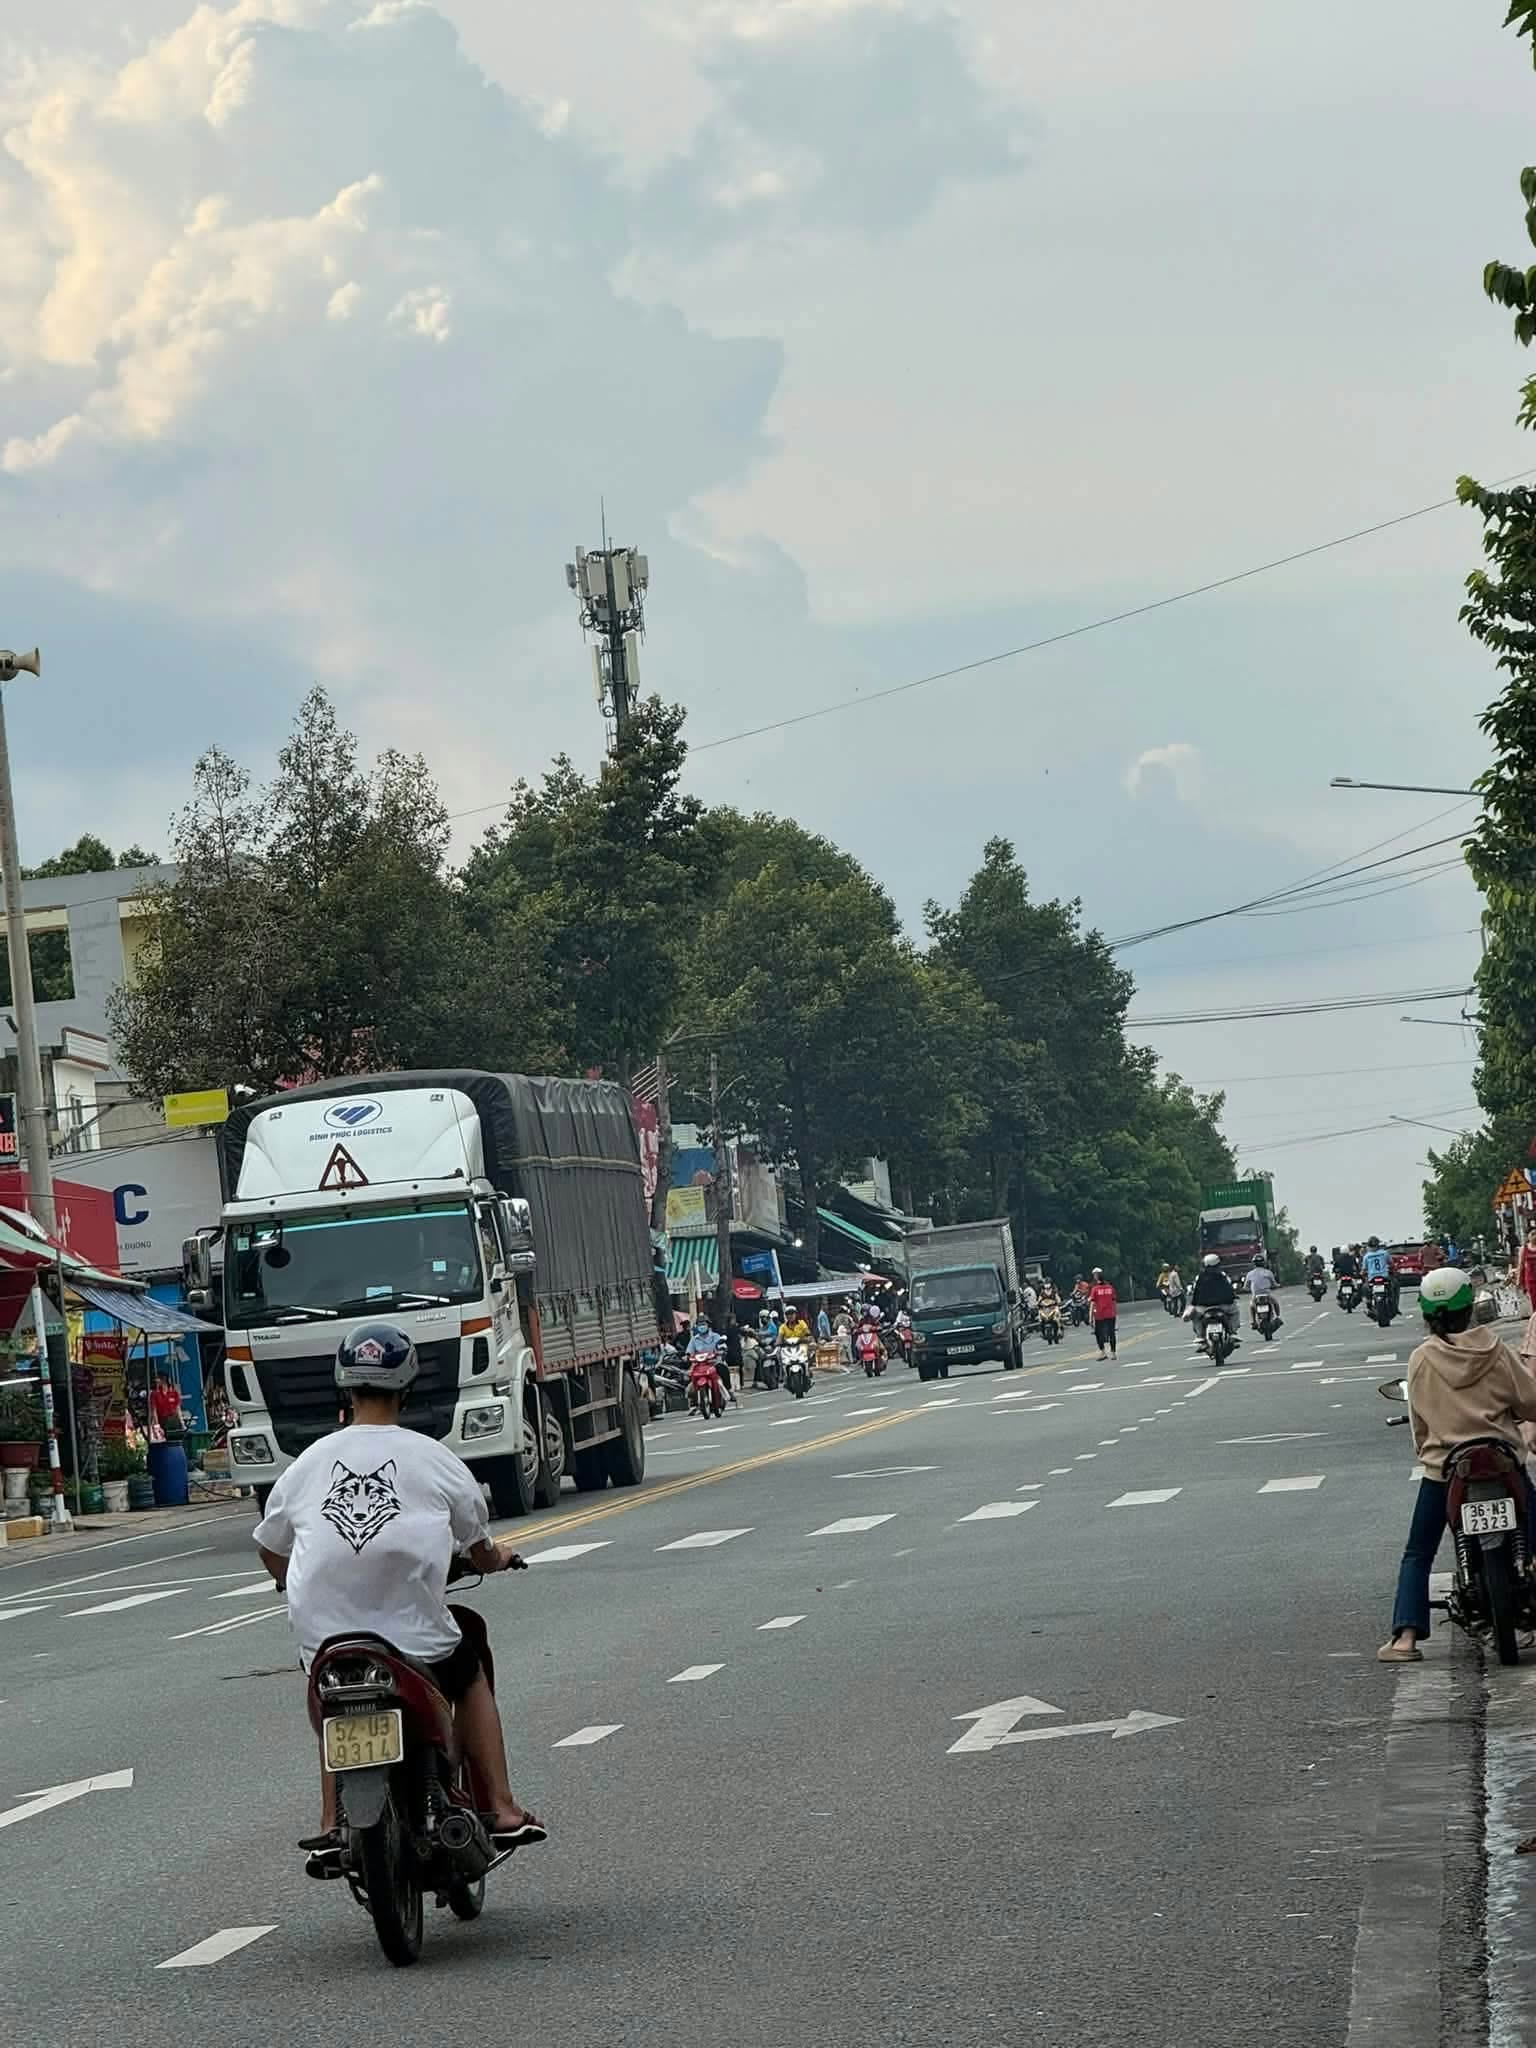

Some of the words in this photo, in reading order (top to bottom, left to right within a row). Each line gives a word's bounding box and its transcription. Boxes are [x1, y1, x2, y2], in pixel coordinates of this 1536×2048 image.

[353, 1127, 393, 1137] LOGISTICS
[113, 1184, 150, 1226] C
[1471, 1515, 1509, 1532] 2323
[344, 1703, 377, 1713] YAMAHA
